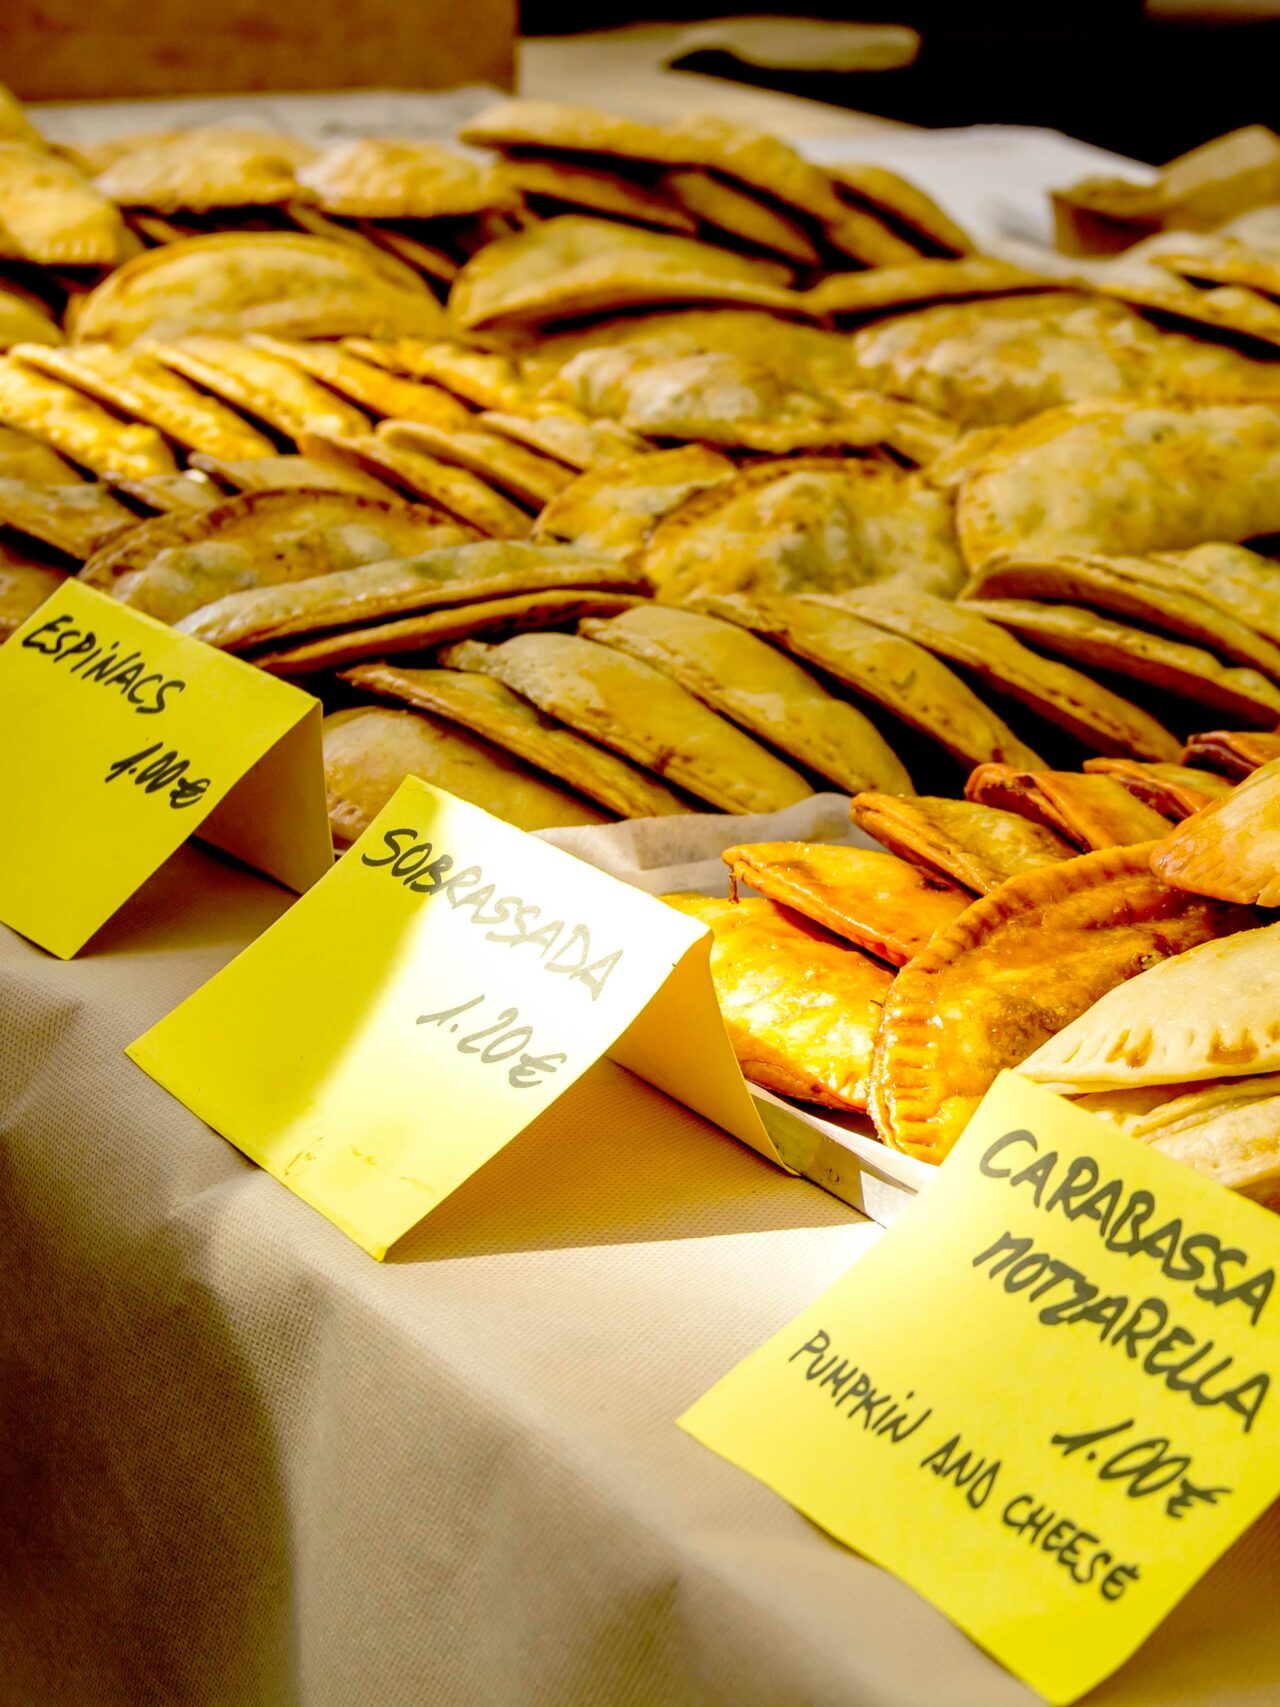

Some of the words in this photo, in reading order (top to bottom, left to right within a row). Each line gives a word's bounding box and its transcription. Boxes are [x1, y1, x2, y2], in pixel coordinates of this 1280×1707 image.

[361, 828, 624, 1001] SOBRASSADA
[415, 994, 567, 1088] 1.20€
[979, 1128, 1276, 1326] CARABASSA
[920, 1434, 1001, 1509] AND
[1002, 1494, 1140, 1601] CHEESE
[1051, 1418, 1233, 1519] 1.00€
